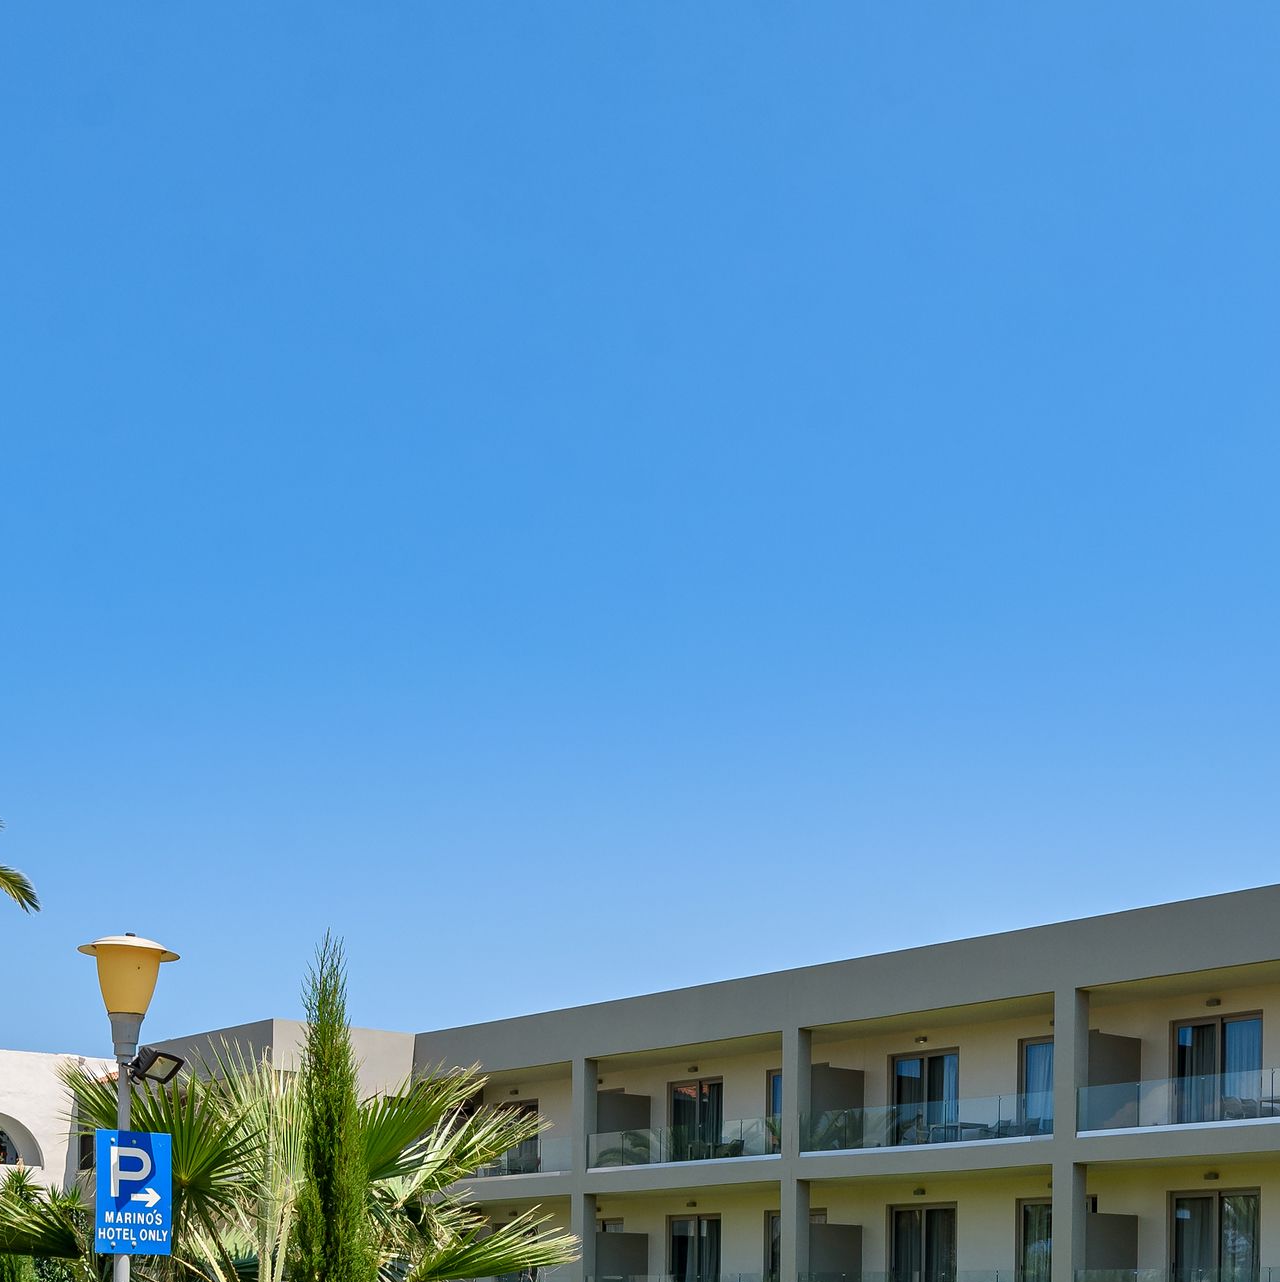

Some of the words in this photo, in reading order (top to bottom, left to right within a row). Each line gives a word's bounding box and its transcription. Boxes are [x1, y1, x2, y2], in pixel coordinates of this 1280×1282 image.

[110, 1145, 152, 1198] P
[98, 1227, 137, 1241] HOTEL
[139, 1228, 169, 1242] ONLY
